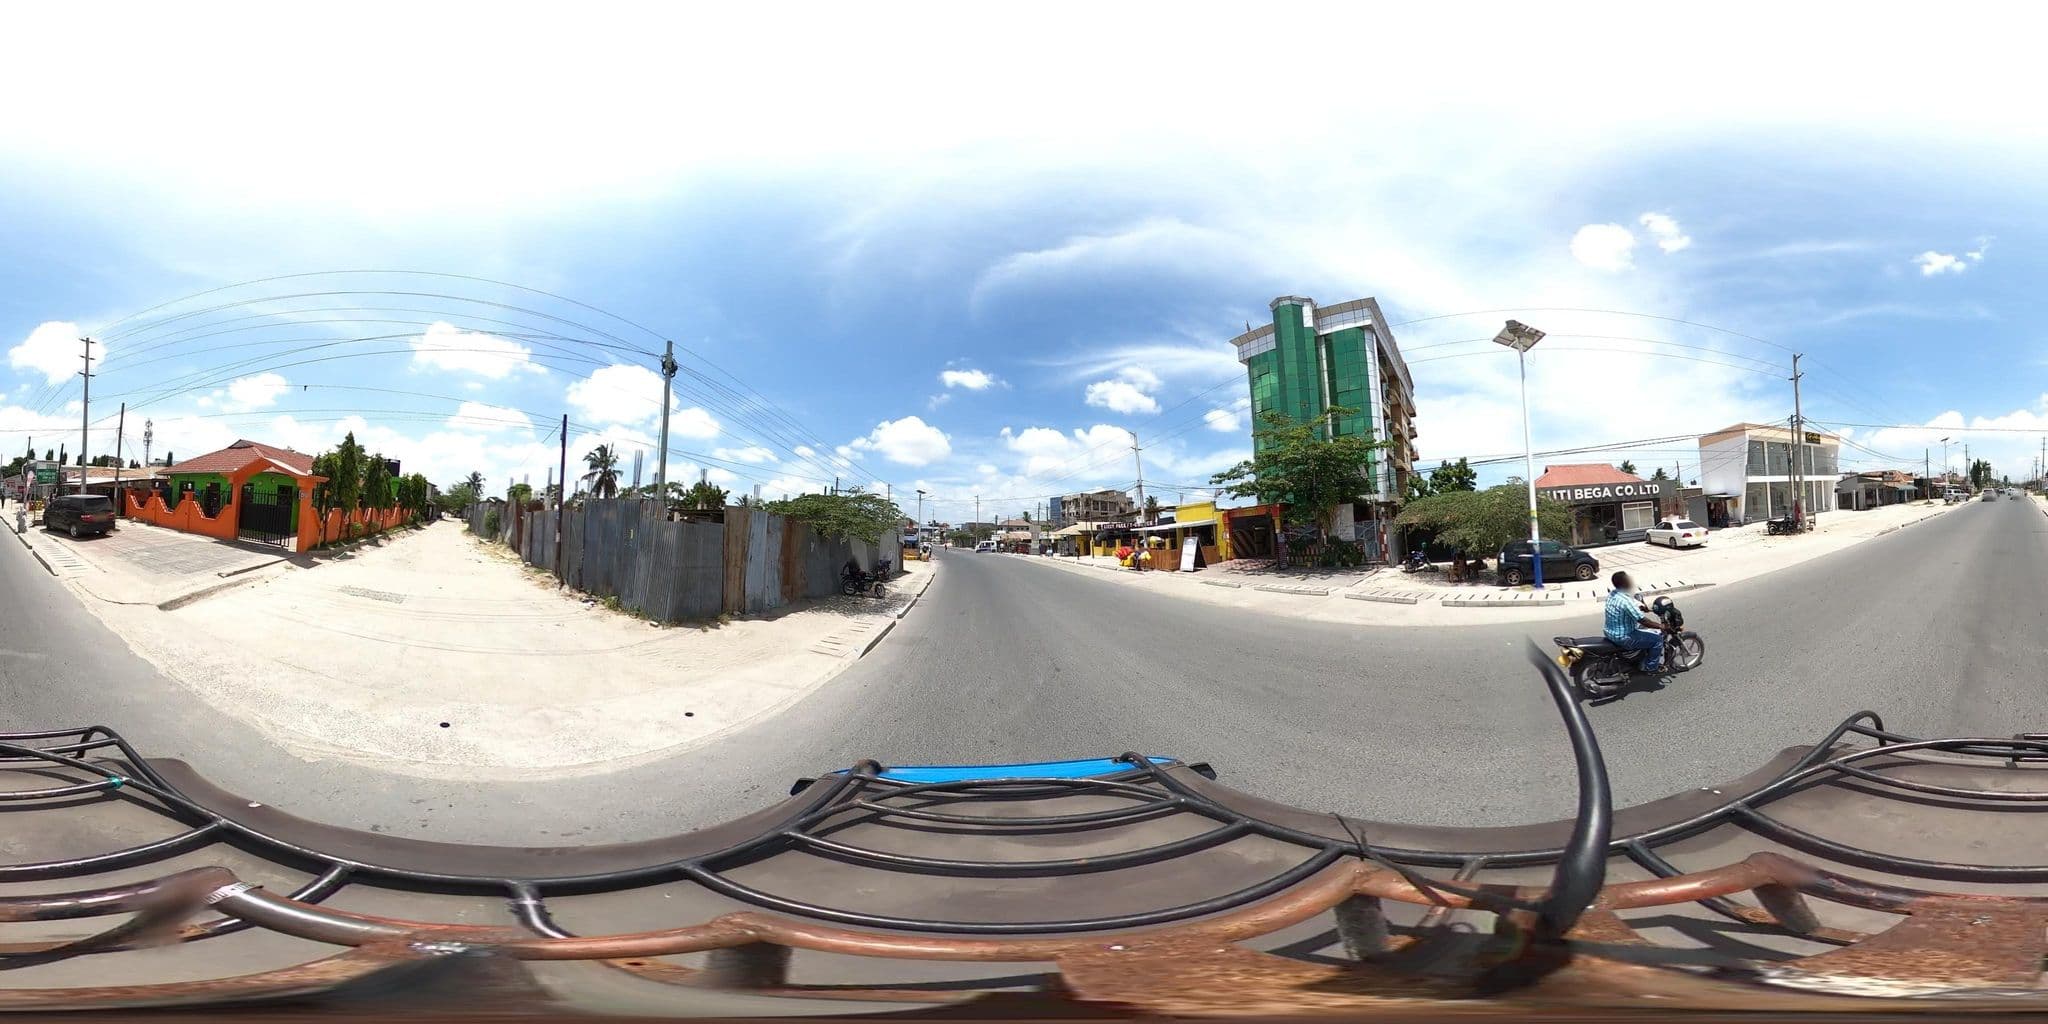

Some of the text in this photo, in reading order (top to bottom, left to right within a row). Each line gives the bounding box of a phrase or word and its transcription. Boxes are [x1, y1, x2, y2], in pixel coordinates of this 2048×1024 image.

[1574, 487, 1612, 500] BEGA
[1615, 485, 1637, 496] CO.
[1639, 484, 1660, 495] LTD
